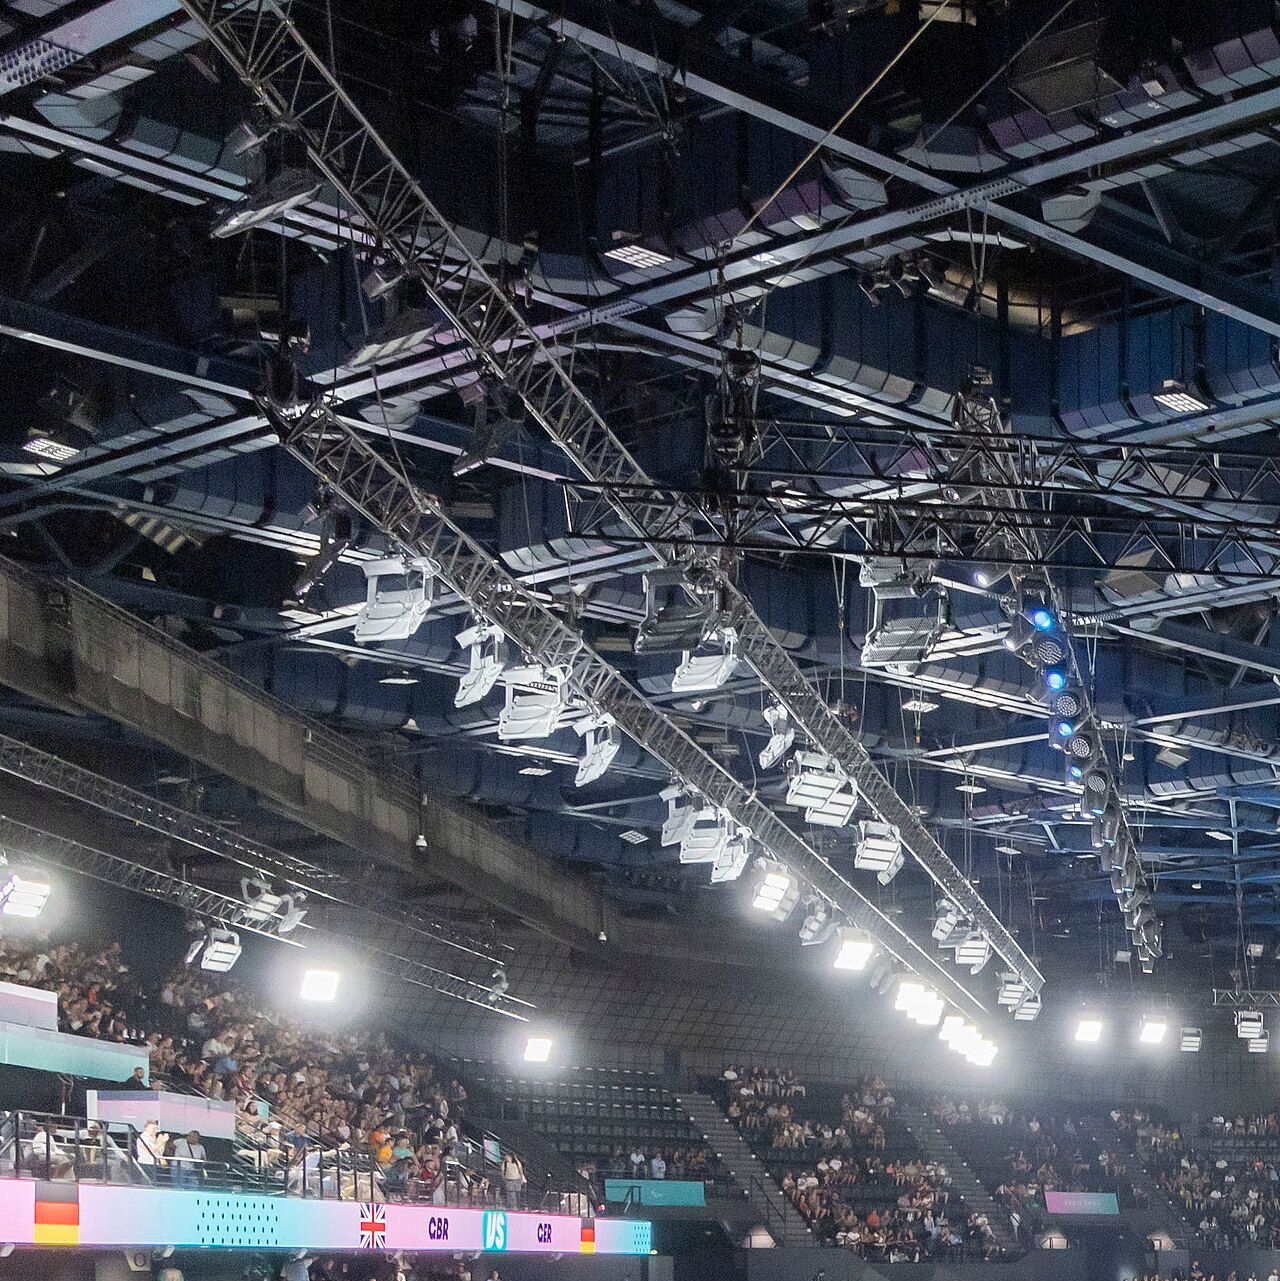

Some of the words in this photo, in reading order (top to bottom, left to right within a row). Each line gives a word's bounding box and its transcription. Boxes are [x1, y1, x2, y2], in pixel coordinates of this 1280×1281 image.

[428, 1216, 449, 1241] GBR
[485, 1212, 505, 1249] VS
[537, 1222, 552, 1244] GER
